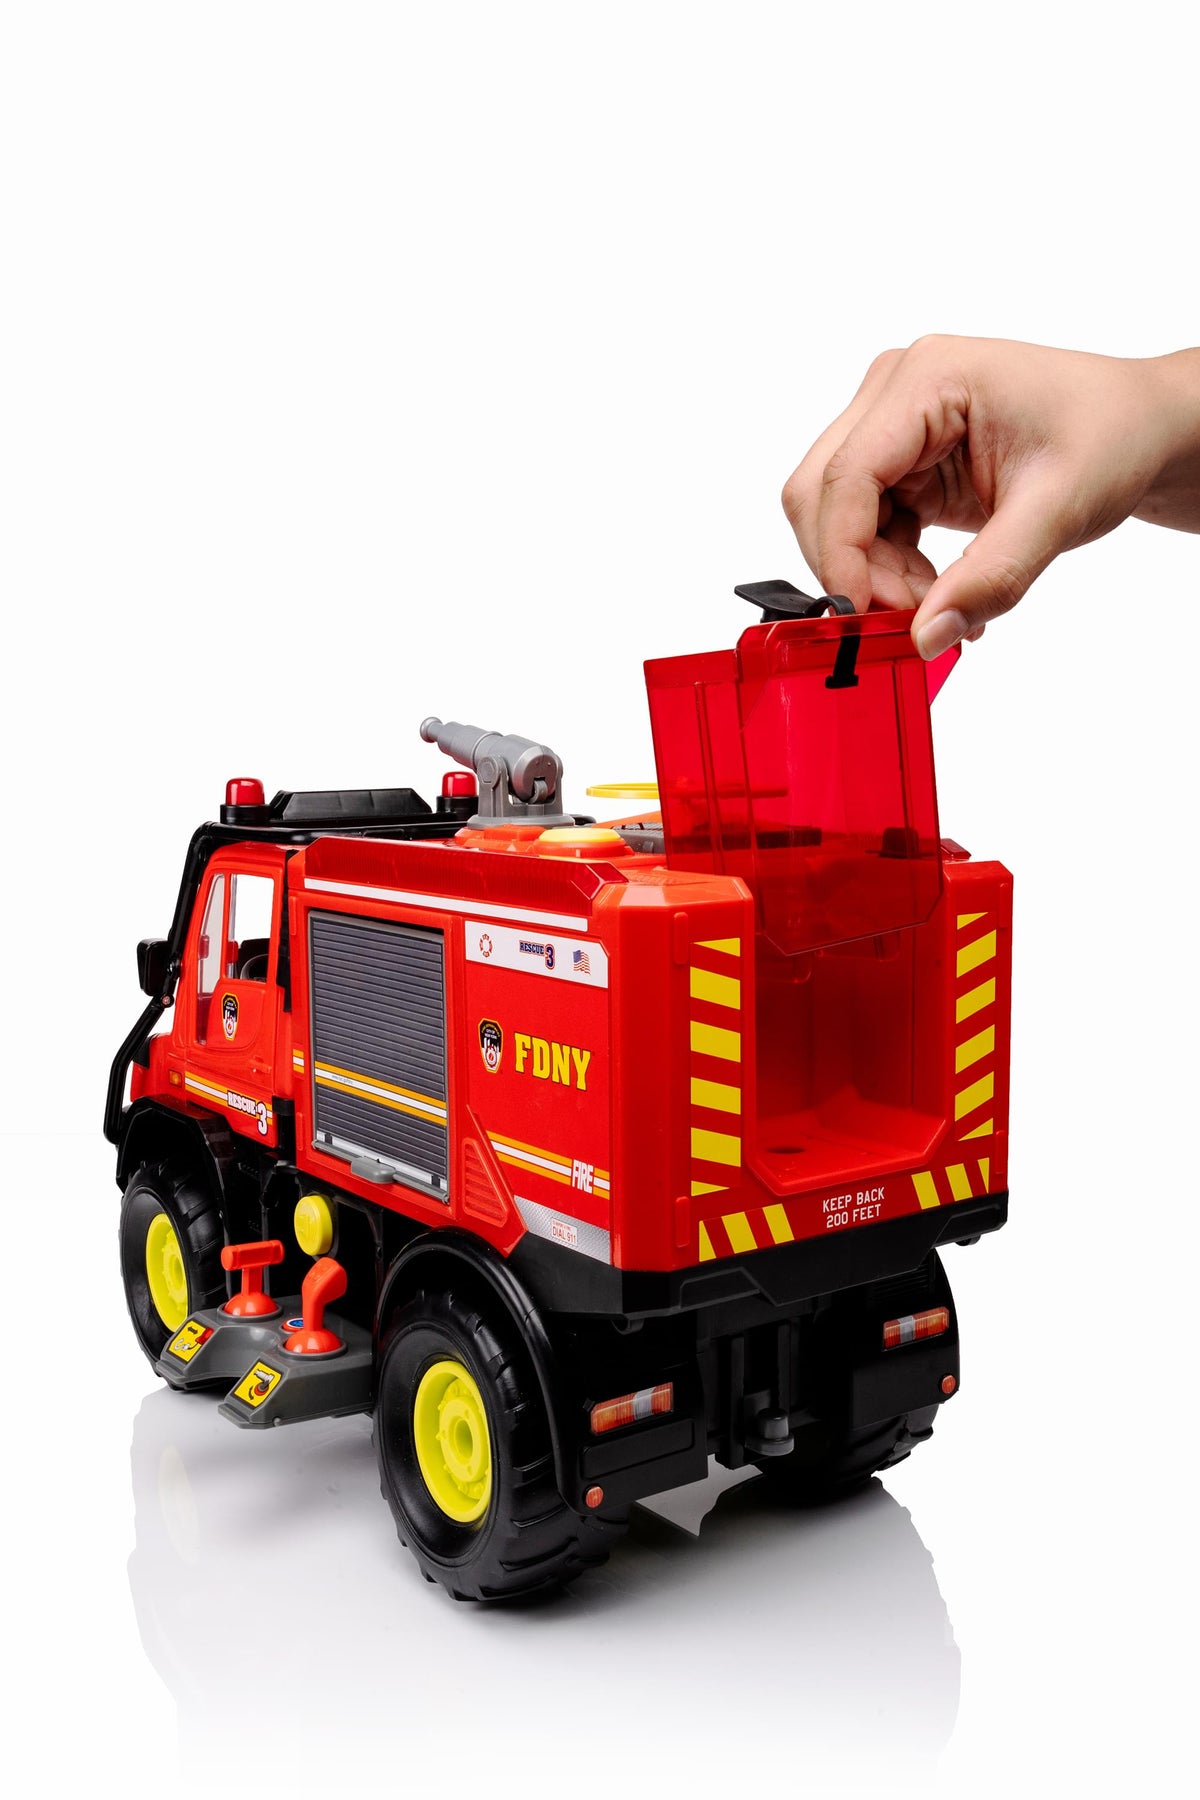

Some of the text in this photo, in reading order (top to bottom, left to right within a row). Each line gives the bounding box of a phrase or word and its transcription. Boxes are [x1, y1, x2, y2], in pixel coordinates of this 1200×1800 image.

[519, 940, 555, 970] RESCUE 3
[514, 1031, 591, 1091] FDNY
[227, 1090, 268, 1135] RESCUE 3
[572, 1159, 594, 1194] FIRE
[823, 1187, 885, 1213] KEEP BACK
[826, 1204, 881, 1229] 200 FEET
[553, 1226, 576, 1244] DIAL 911
